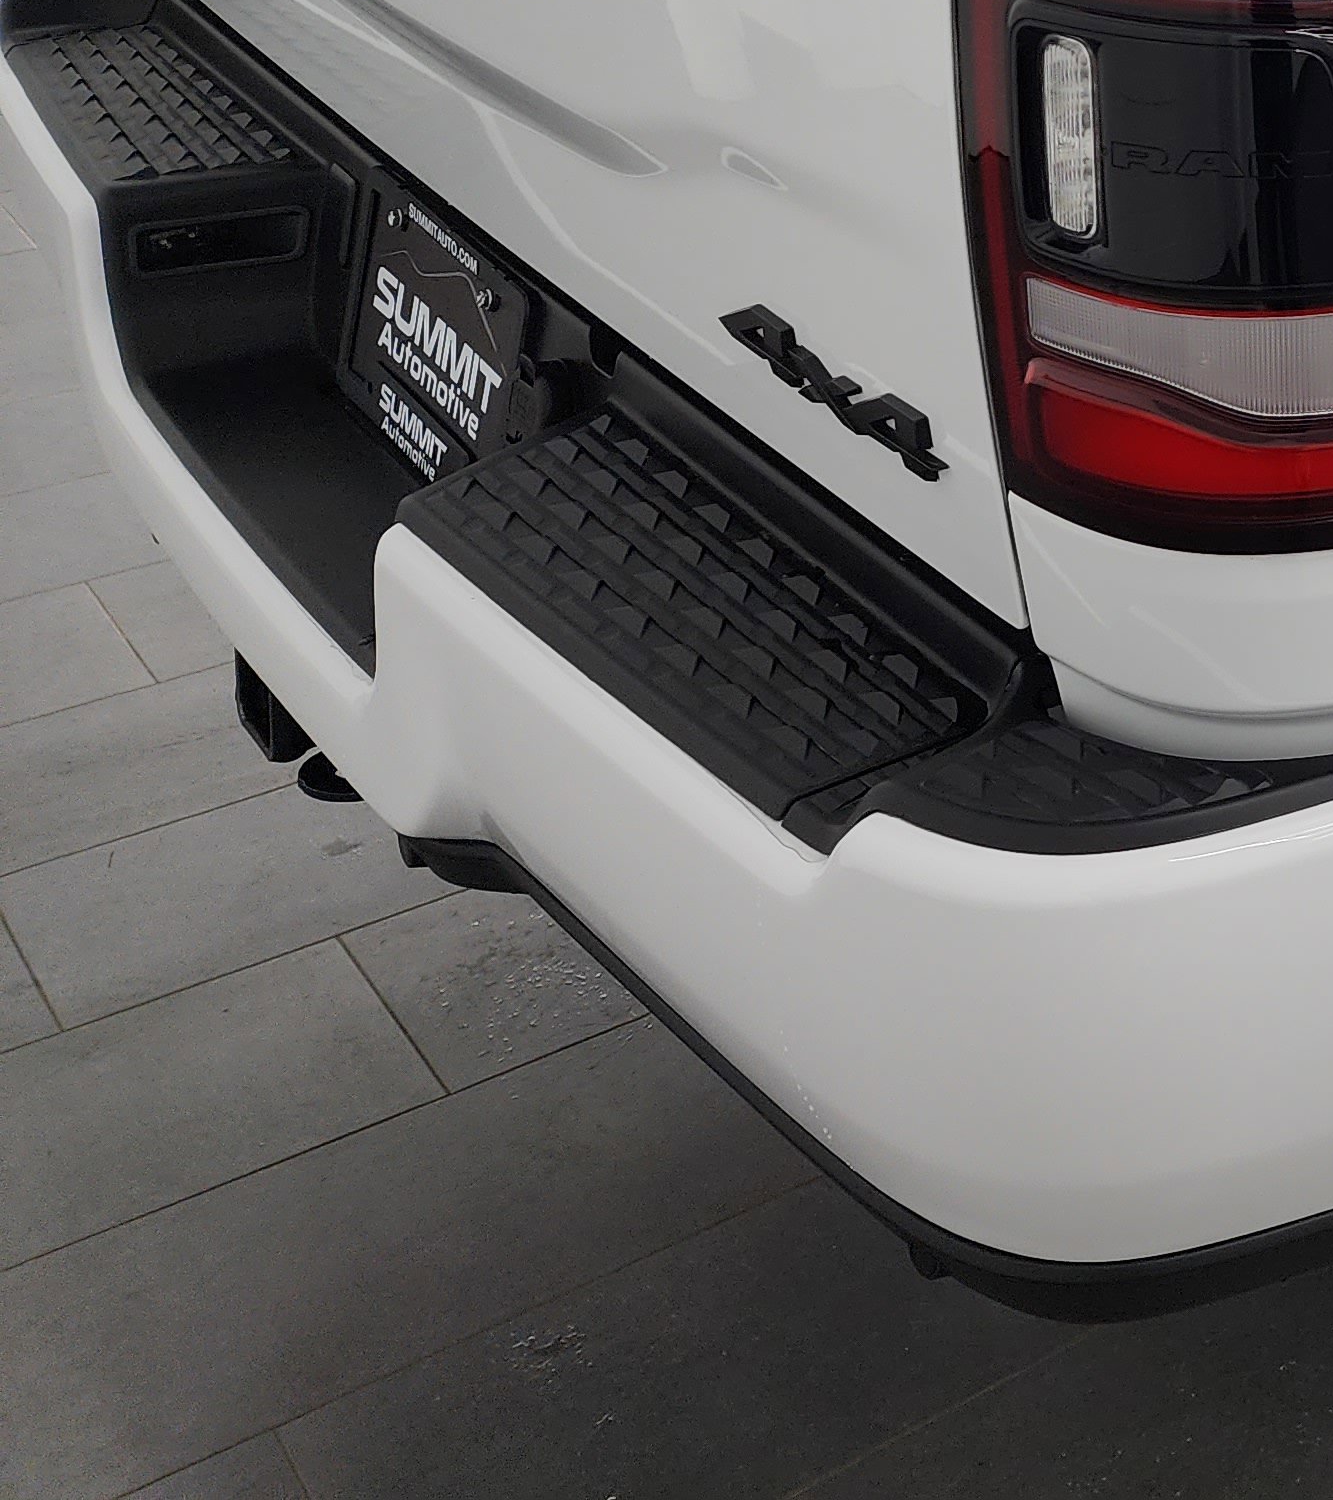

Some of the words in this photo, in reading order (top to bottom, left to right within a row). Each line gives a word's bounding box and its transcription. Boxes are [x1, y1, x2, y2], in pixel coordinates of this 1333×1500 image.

[1110, 140, 1332, 179] RAM
[408, 202, 479, 276] SUMMITAUTO.COM
[372, 266, 503, 415] SUMMIT
[377, 321, 480, 441] Automotive
[378, 383, 448, 468] SUMMIT
[380, 415, 437, 483] Automotive
